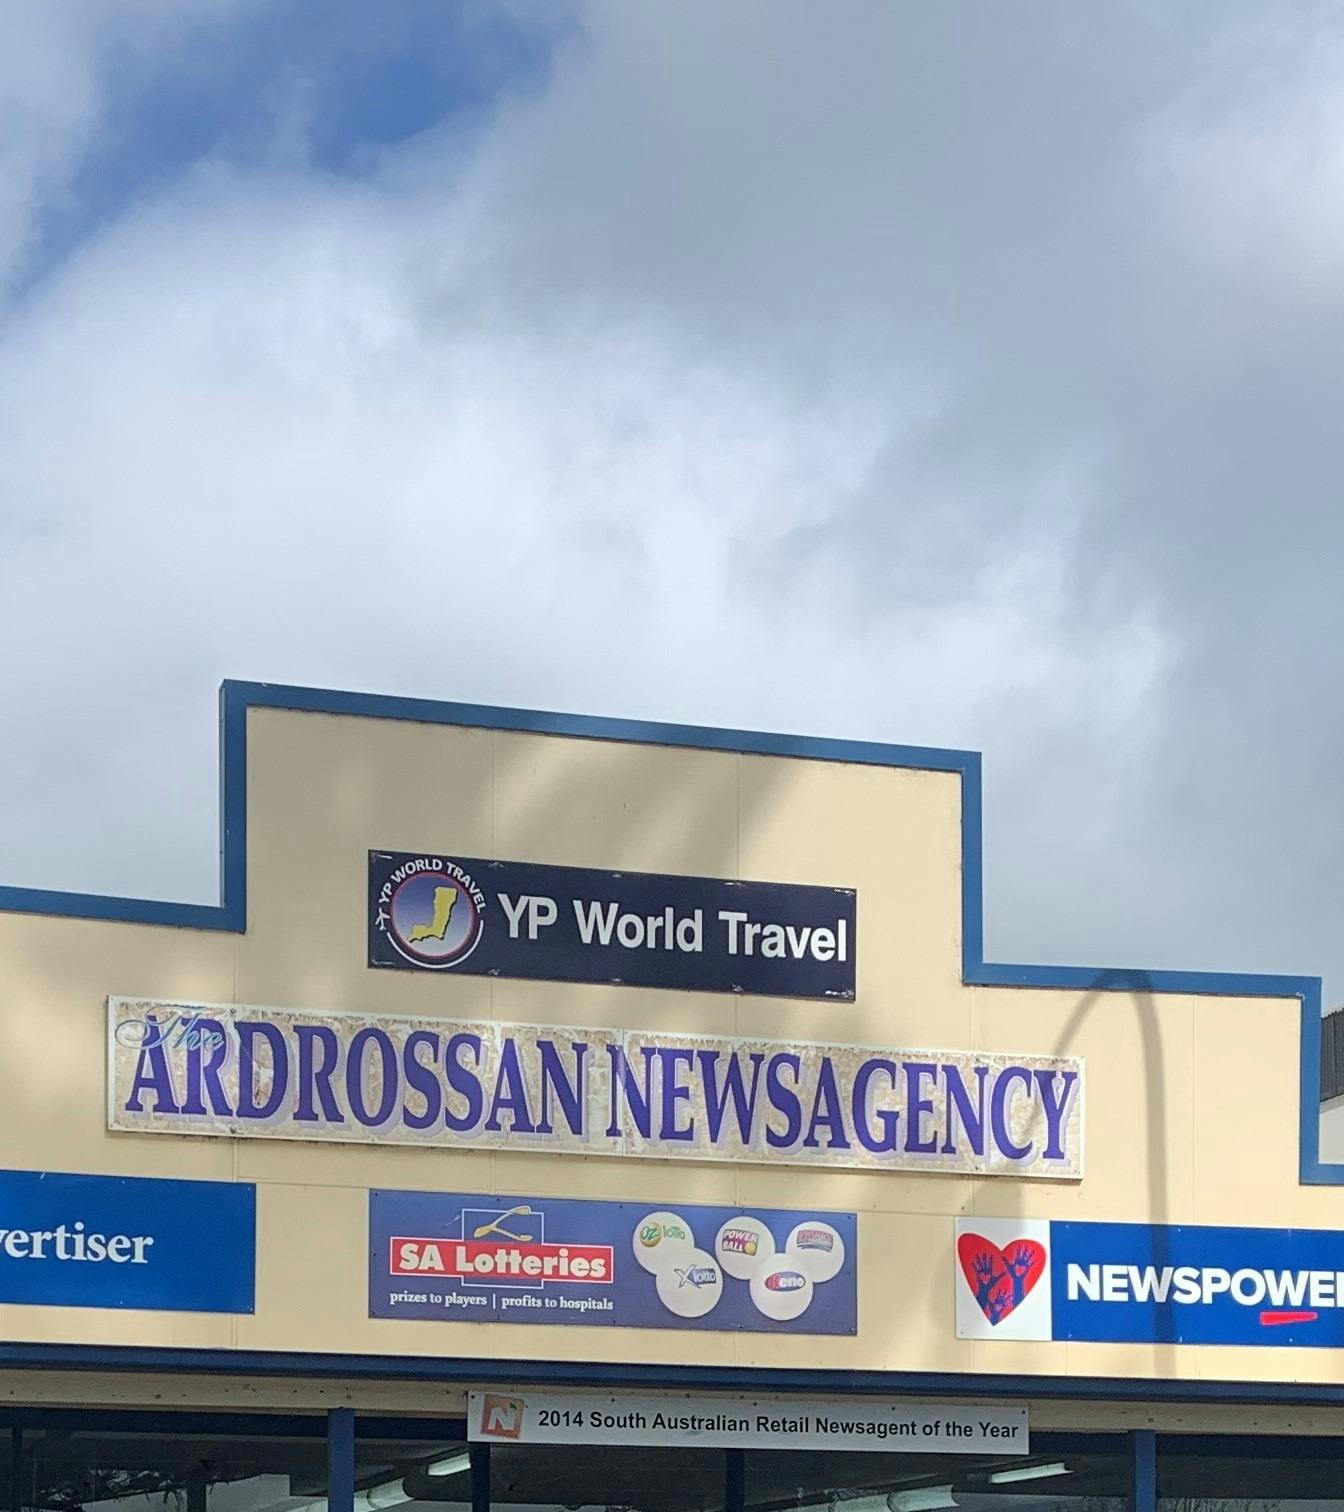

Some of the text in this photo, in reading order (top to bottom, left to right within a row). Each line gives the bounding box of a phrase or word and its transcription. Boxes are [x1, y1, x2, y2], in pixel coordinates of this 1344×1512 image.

[378, 858, 486, 914] YP WORLD TRAVEL
[497, 892, 849, 963] YP World Travel
[114, 1004, 227, 1052] The
[123, 1013, 1080, 1162] ARDROSSAN NEWSAGENCY
[722, 1228, 758, 1243] POWER
[722, 1240, 745, 1252] BALL
[398, 1242, 607, 1279] SA Lotteries
[389, 1290, 614, 1313] prizes to players profits to hospitals
[538, 1410, 1019, 1439] 2014 South Australian Retail Newsagent of the Year
